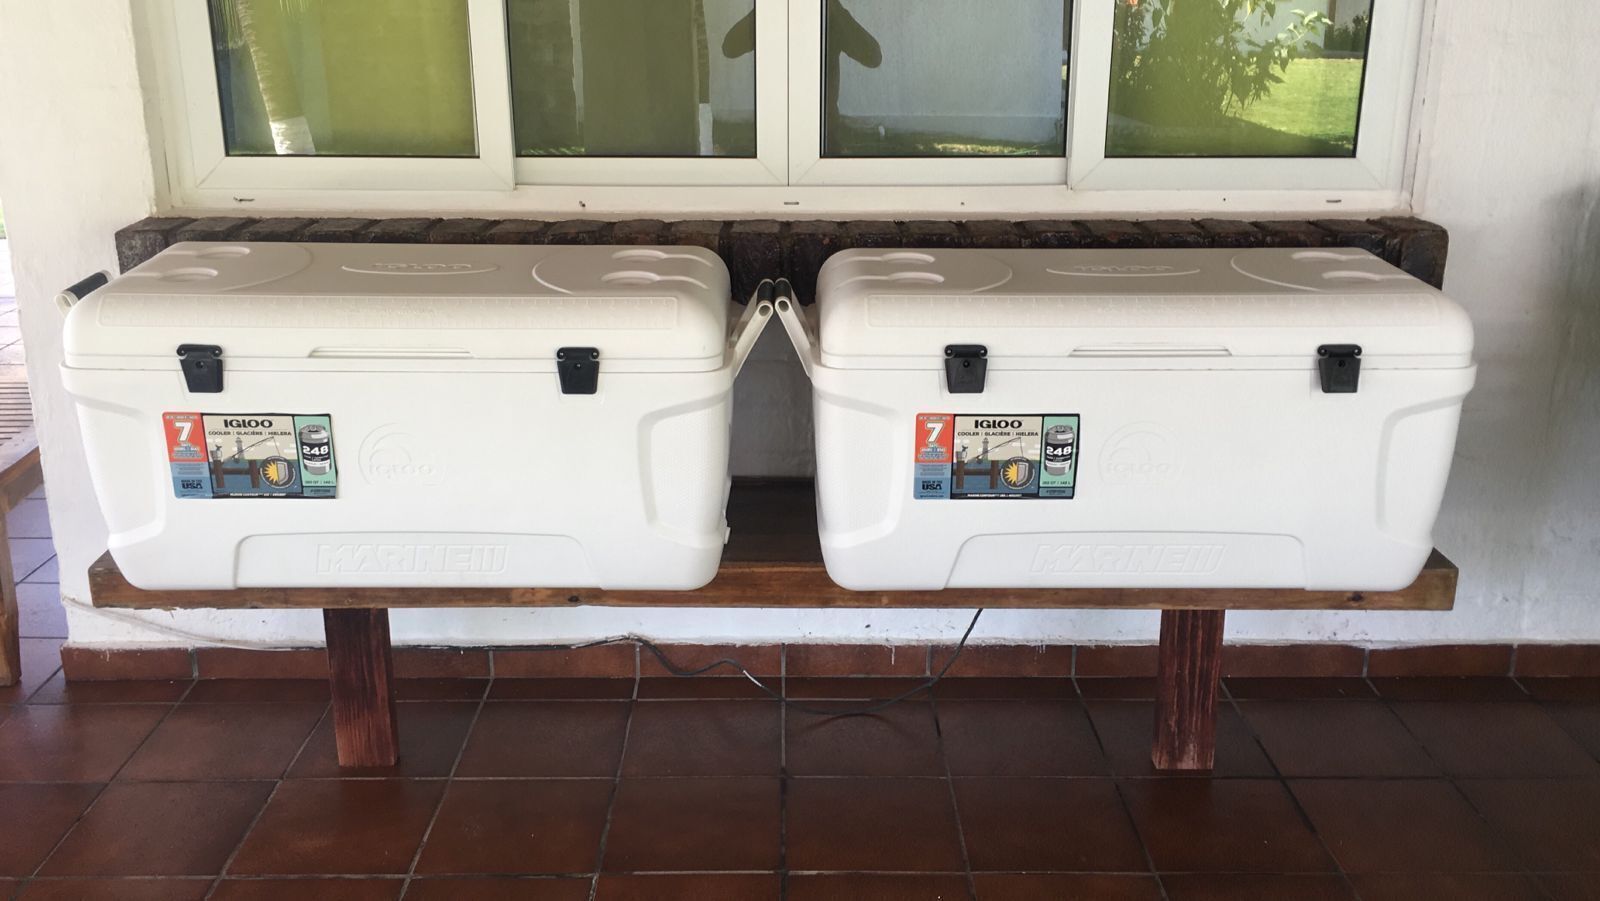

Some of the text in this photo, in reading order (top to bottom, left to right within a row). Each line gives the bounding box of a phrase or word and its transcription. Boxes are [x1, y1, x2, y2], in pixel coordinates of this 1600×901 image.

[223, 419, 273, 428] IGLOO
[974, 419, 1022, 429] IGLOO
[175, 421, 192, 442] 7
[926, 421, 944, 442] 7
[302, 445, 329, 455] 248
[1046, 445, 1072, 456] 248
